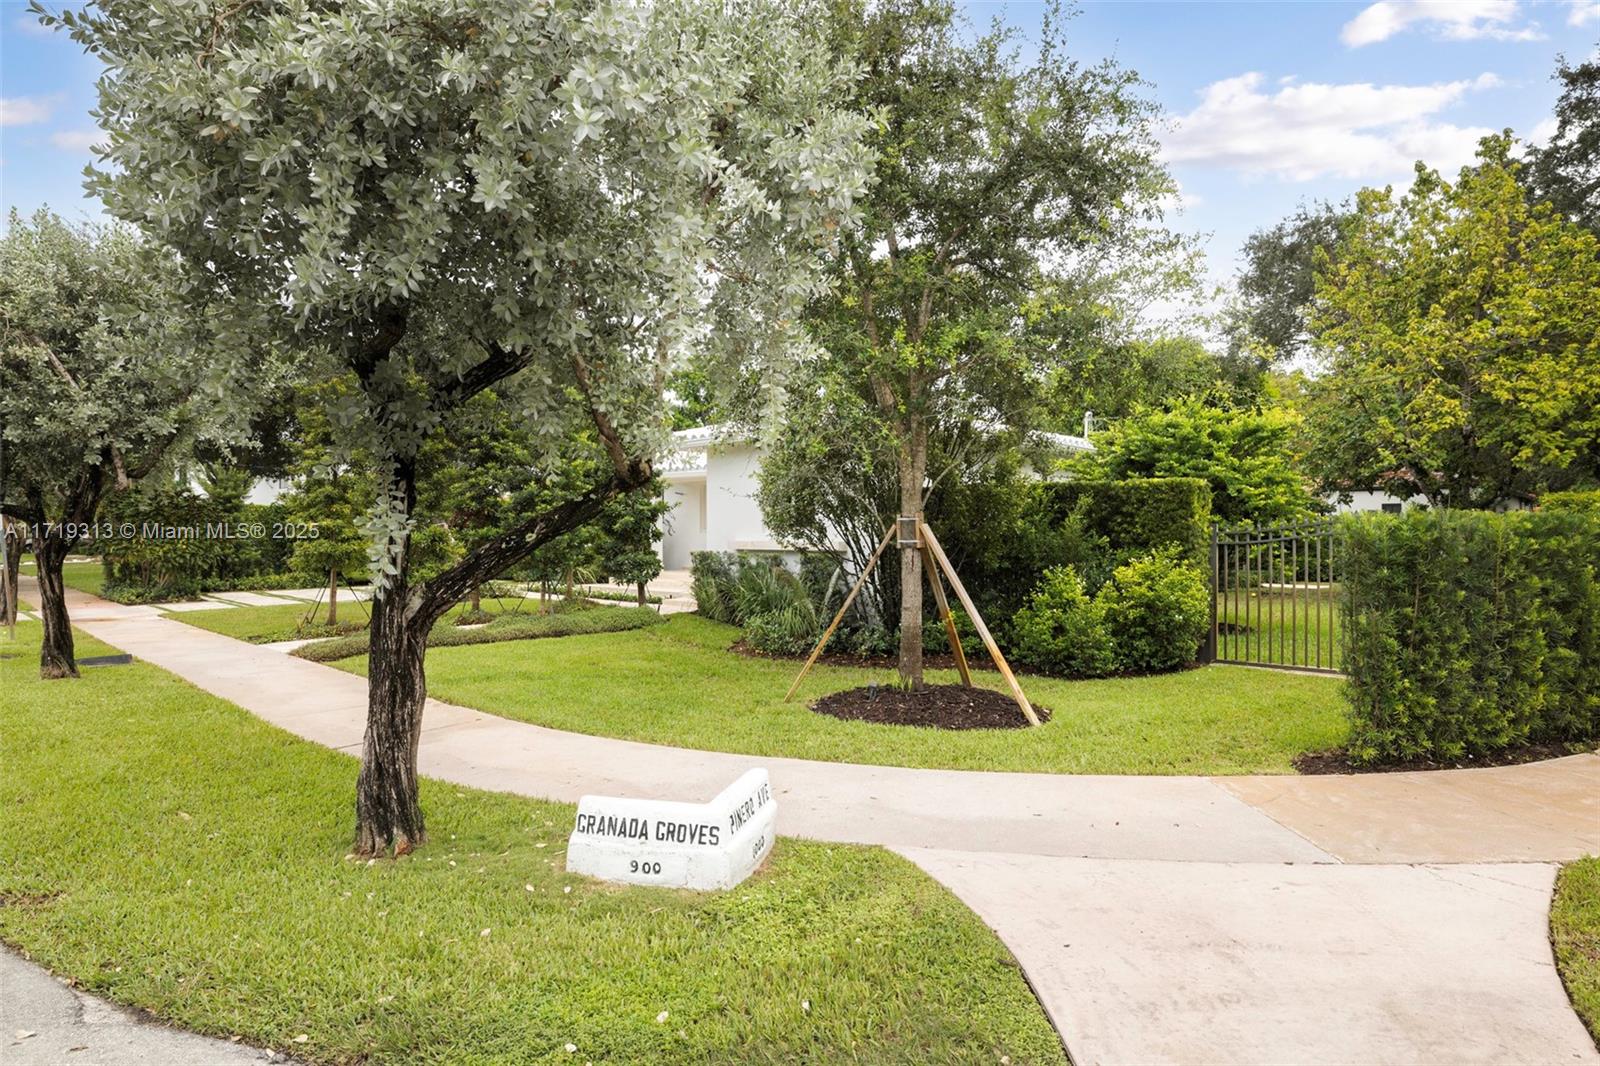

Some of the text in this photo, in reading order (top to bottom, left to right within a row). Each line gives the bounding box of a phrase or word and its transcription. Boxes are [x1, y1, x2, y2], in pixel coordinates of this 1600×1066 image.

[729, 783, 770, 836] PINERO AVE
[577, 813, 720, 846] GRANADA GROVES
[629, 859, 662, 875] 900
